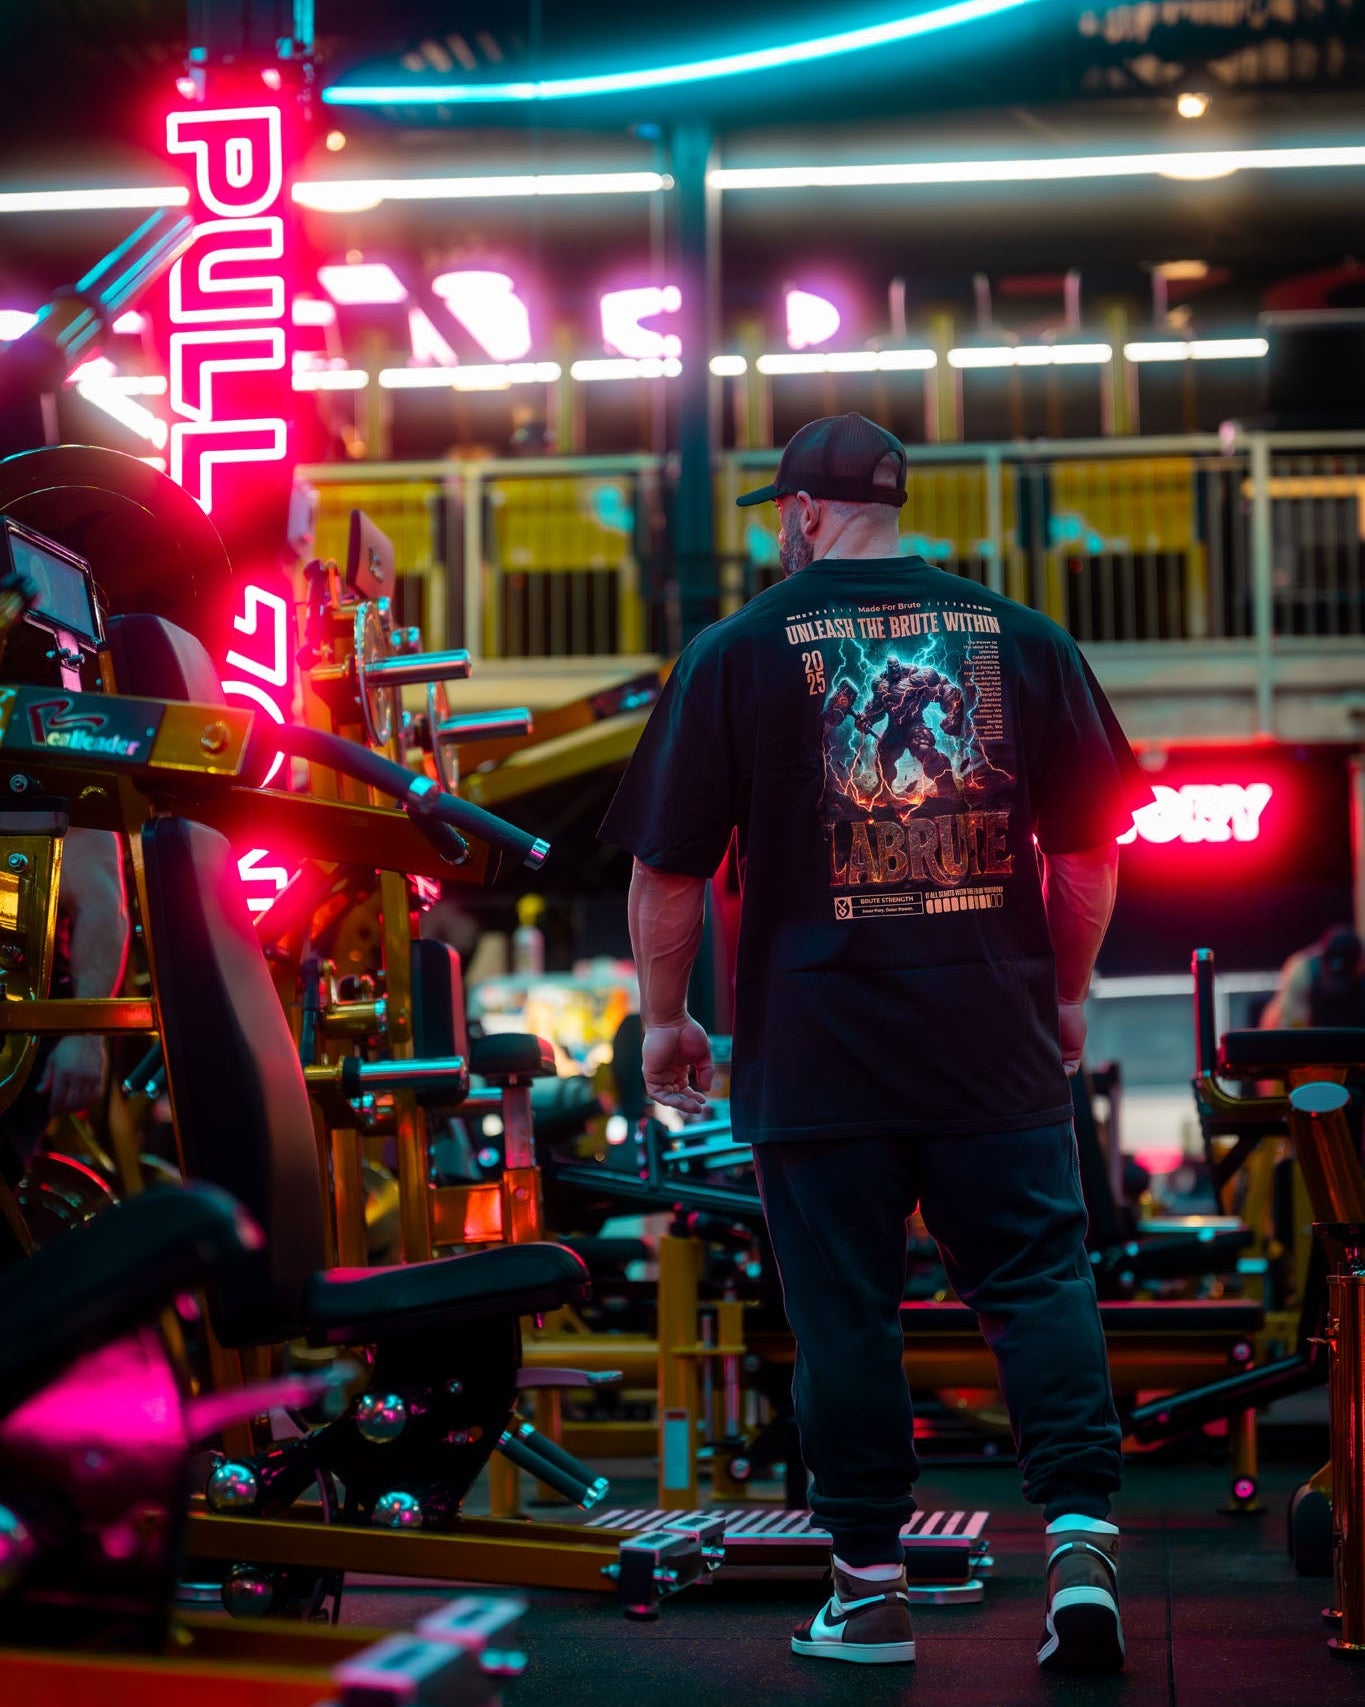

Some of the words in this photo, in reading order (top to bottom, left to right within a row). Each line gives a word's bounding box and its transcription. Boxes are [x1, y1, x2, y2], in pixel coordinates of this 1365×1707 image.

[166, 105, 287, 516] PULL
[858, 605, 880, 613] Made
[882, 604, 896, 612] For
[898, 601, 921, 610] Brute
[784, 618, 856, 645] UNLEASH
[857, 617, 887, 640] THE
[889, 612, 940, 639] BRUTE
[942, 611, 1001, 634] WITHIN
[802, 650, 824, 674] 20
[807, 671, 826, 696] 25
[827, 808, 1015, 887] LABRUTE
[881, 896, 914, 904] STRENGTH
